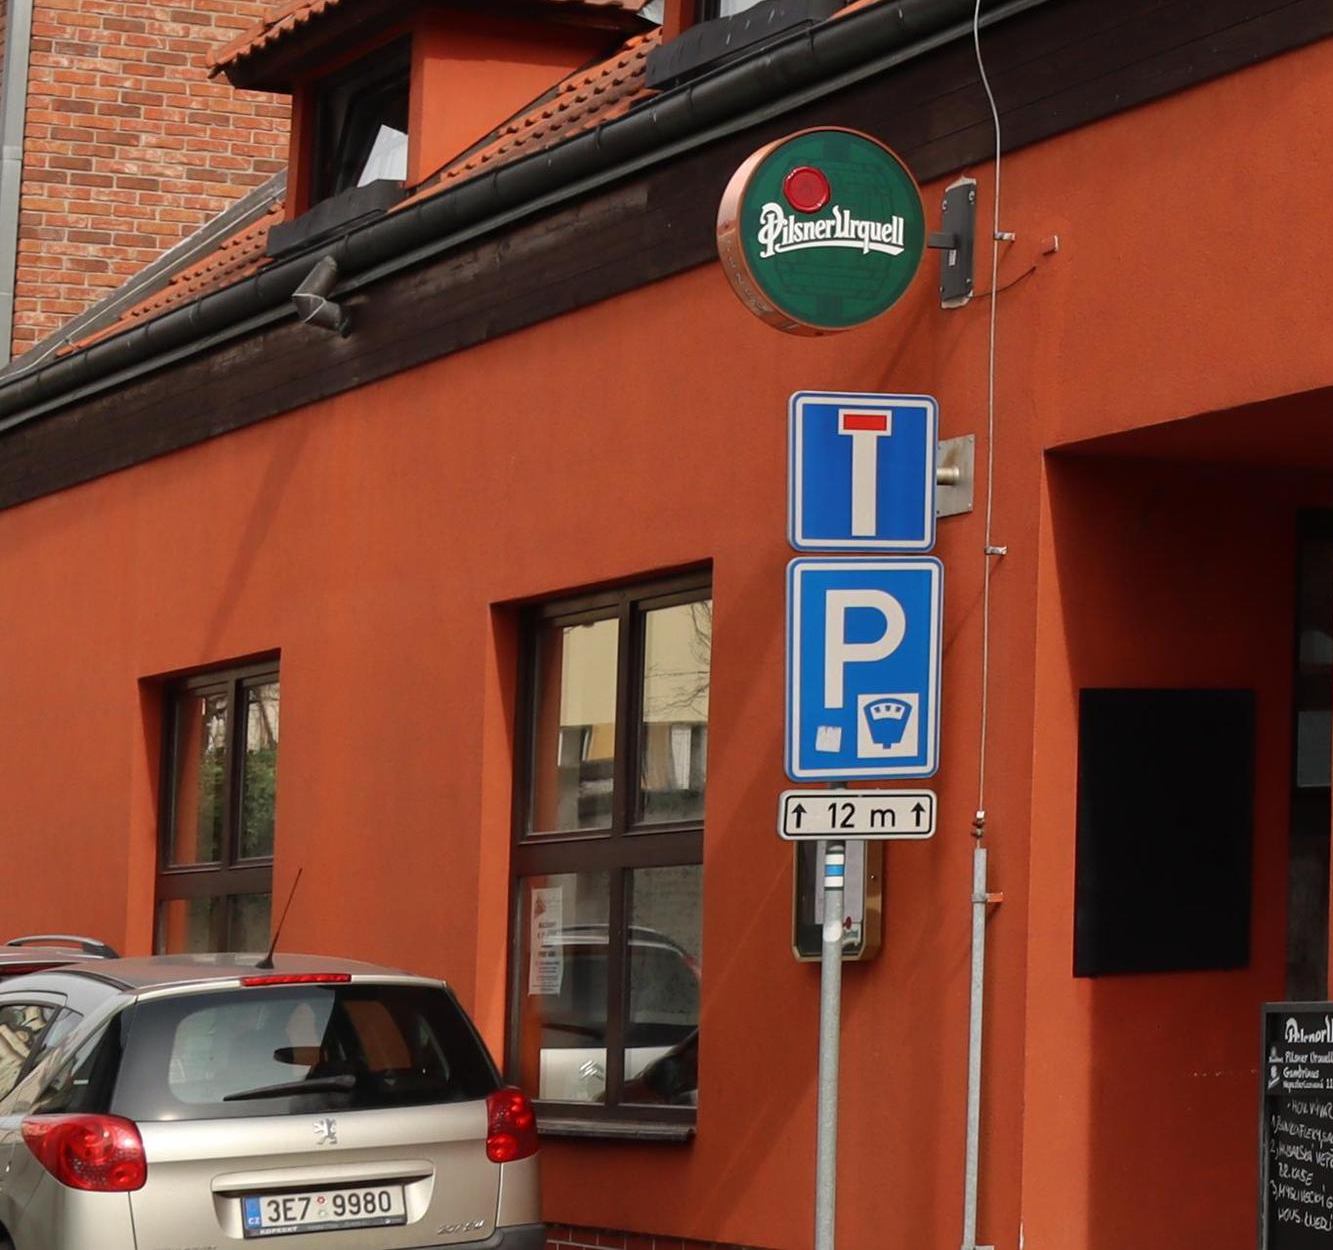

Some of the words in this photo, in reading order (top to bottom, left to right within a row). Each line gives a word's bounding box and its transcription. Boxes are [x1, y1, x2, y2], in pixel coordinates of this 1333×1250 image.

[757, 201, 837, 259] Pilsner
[832, 204, 905, 255] Urquell
[823, 588, 906, 709] P
[828, 803, 855, 829] 12
[869, 807, 896, 828] m
[248, 1217, 260, 1226] CZ
[266, 1196, 312, 1224] 3E7
[333, 1190, 392, 1218] 9980
